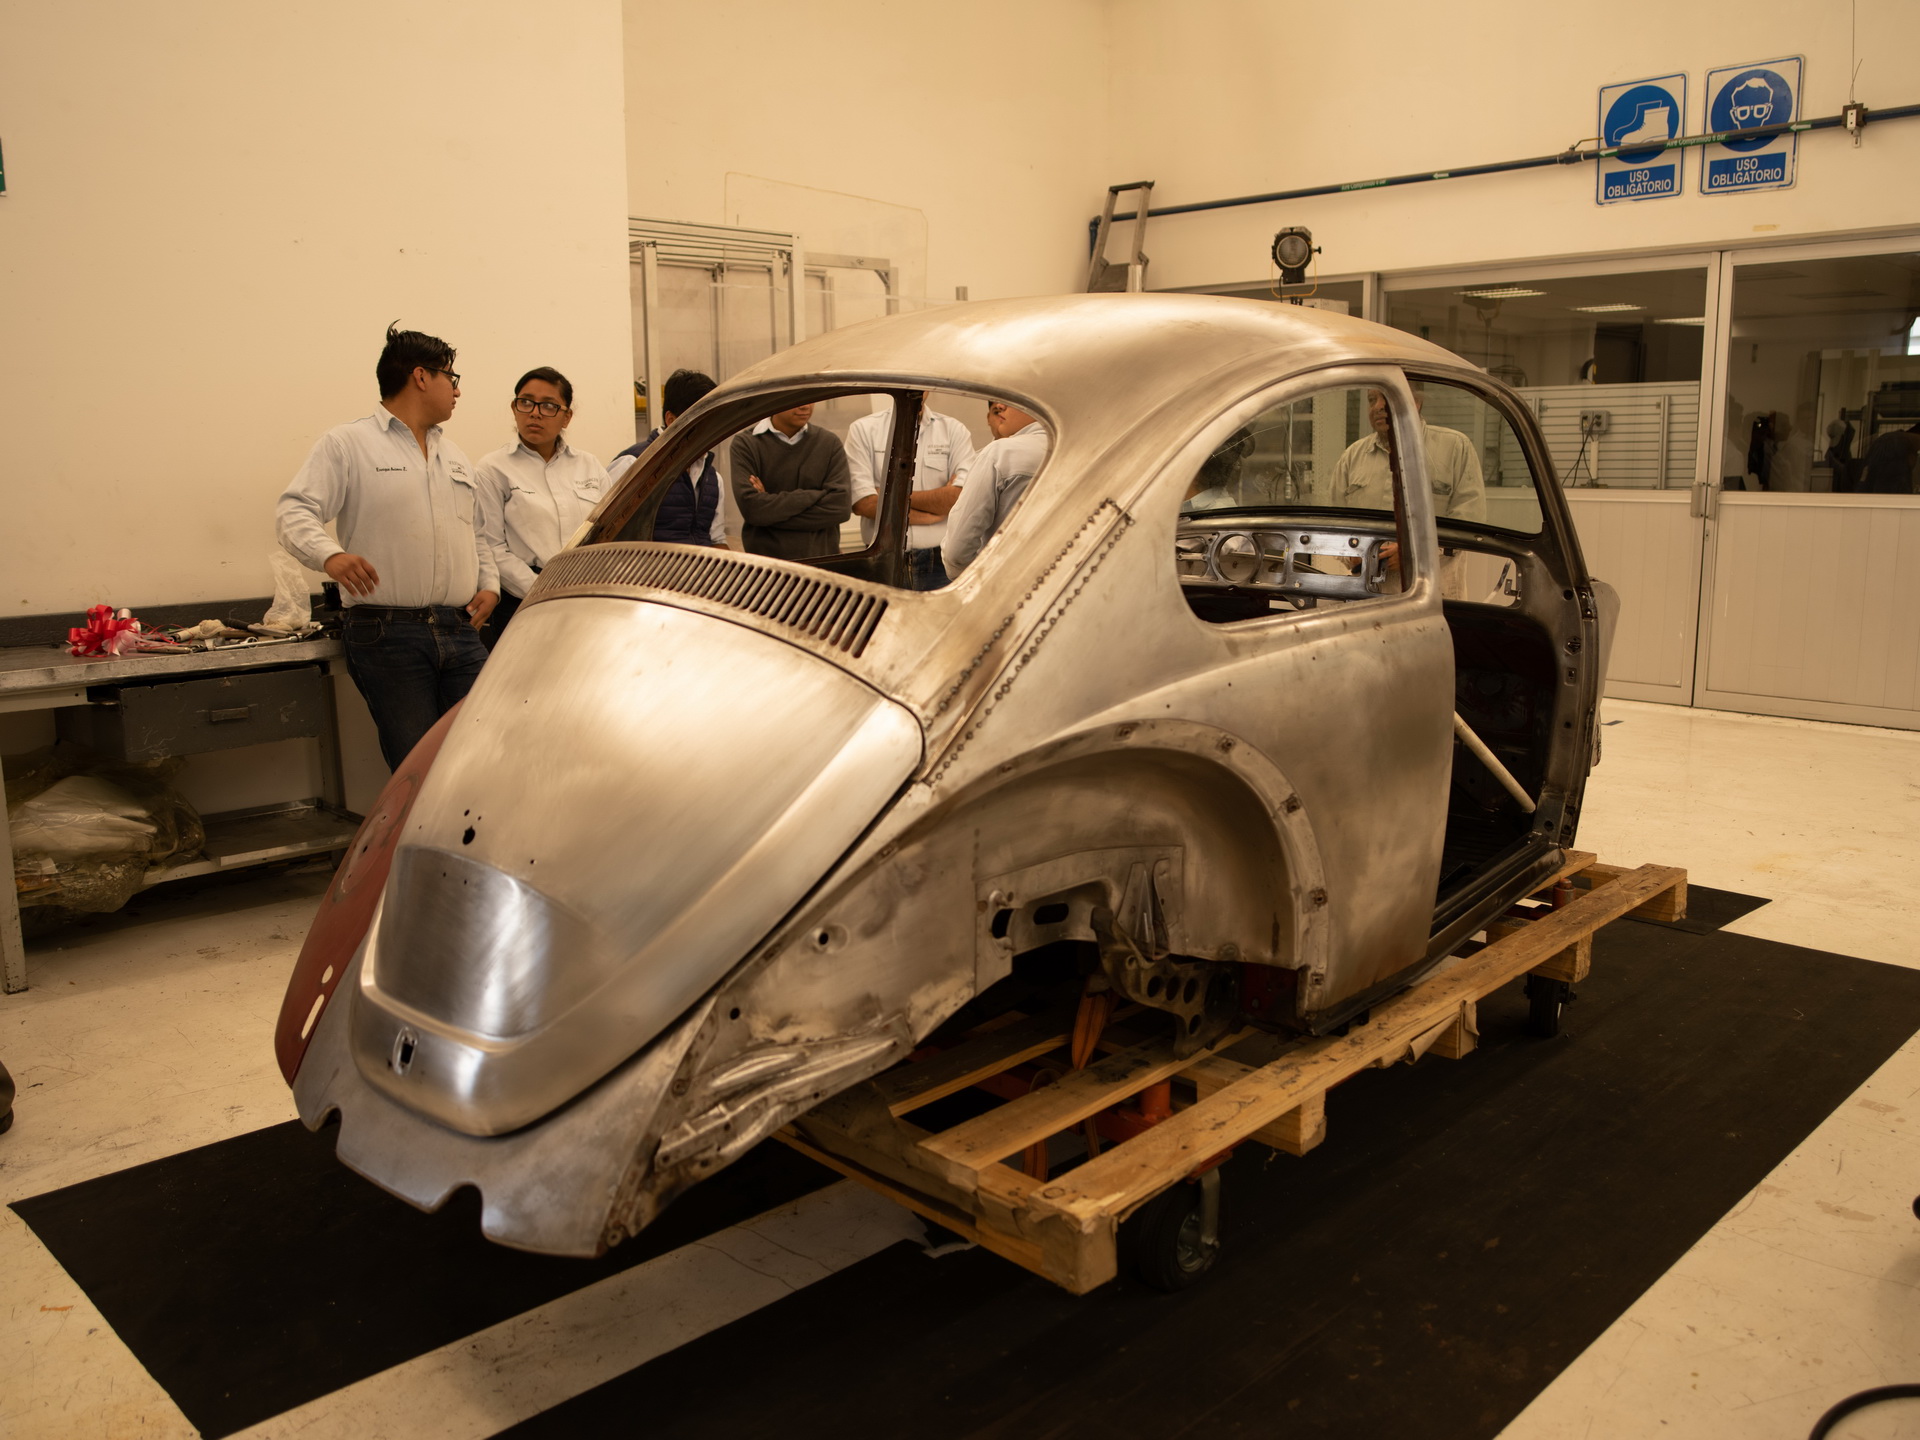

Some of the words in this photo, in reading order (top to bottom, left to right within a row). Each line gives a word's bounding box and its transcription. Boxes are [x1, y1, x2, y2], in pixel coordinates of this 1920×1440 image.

[1736, 158, 1758, 171] USO
[1629, 170, 1650, 182] USO
[1712, 168, 1782, 186] OBLIGATORIO
[1607, 179, 1672, 198] OBLIGATORIO
